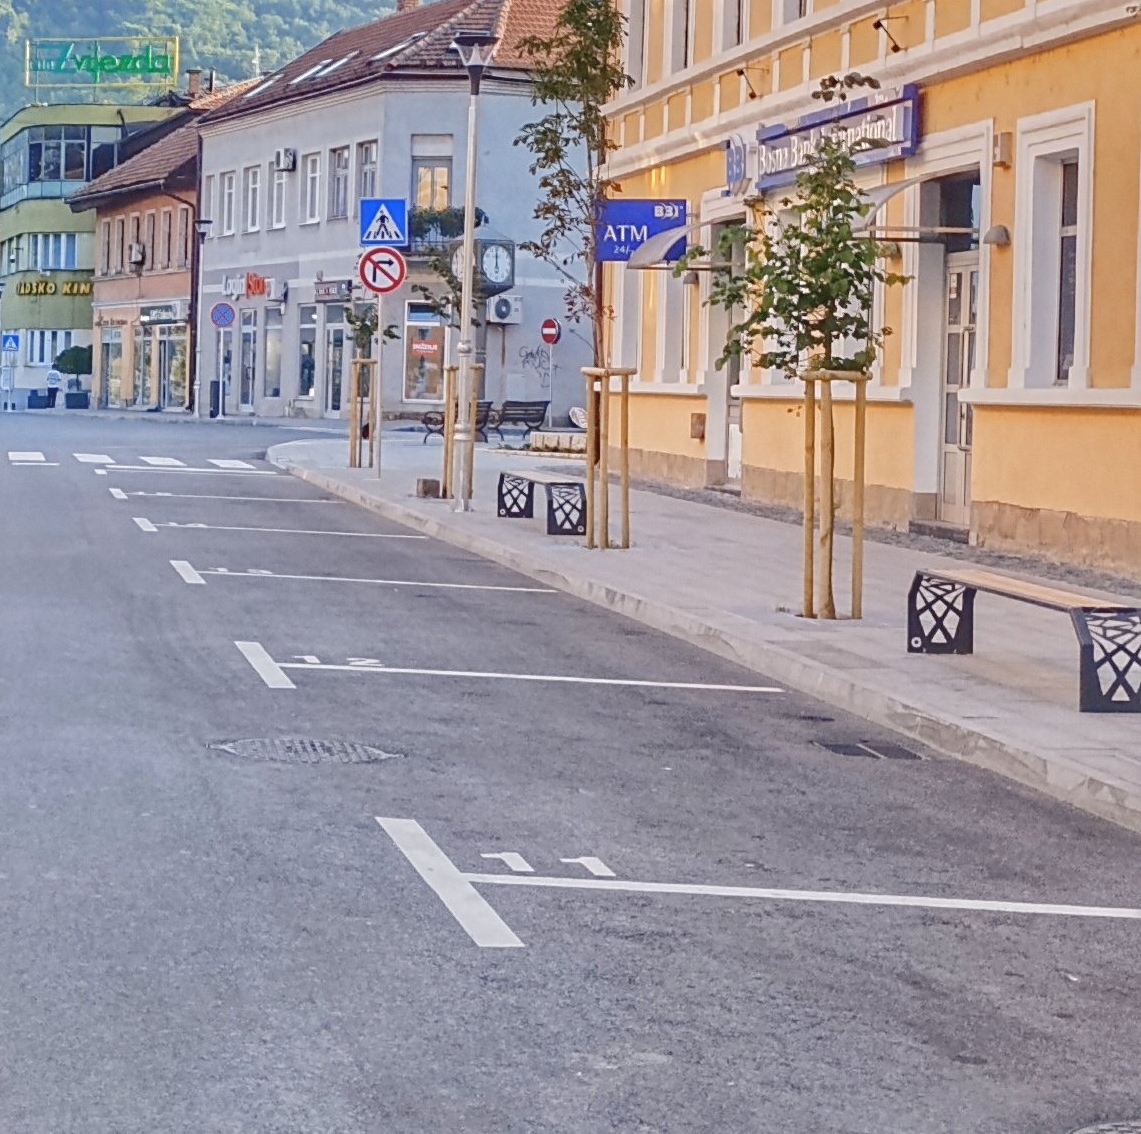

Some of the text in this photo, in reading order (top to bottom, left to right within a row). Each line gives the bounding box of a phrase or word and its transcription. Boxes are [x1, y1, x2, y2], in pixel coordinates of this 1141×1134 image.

[759, 144, 789, 175] Bosna
[603, 224, 648, 242] ATM
[62, 281, 92, 296] KIN
[292, 655, 385, 667] 12
